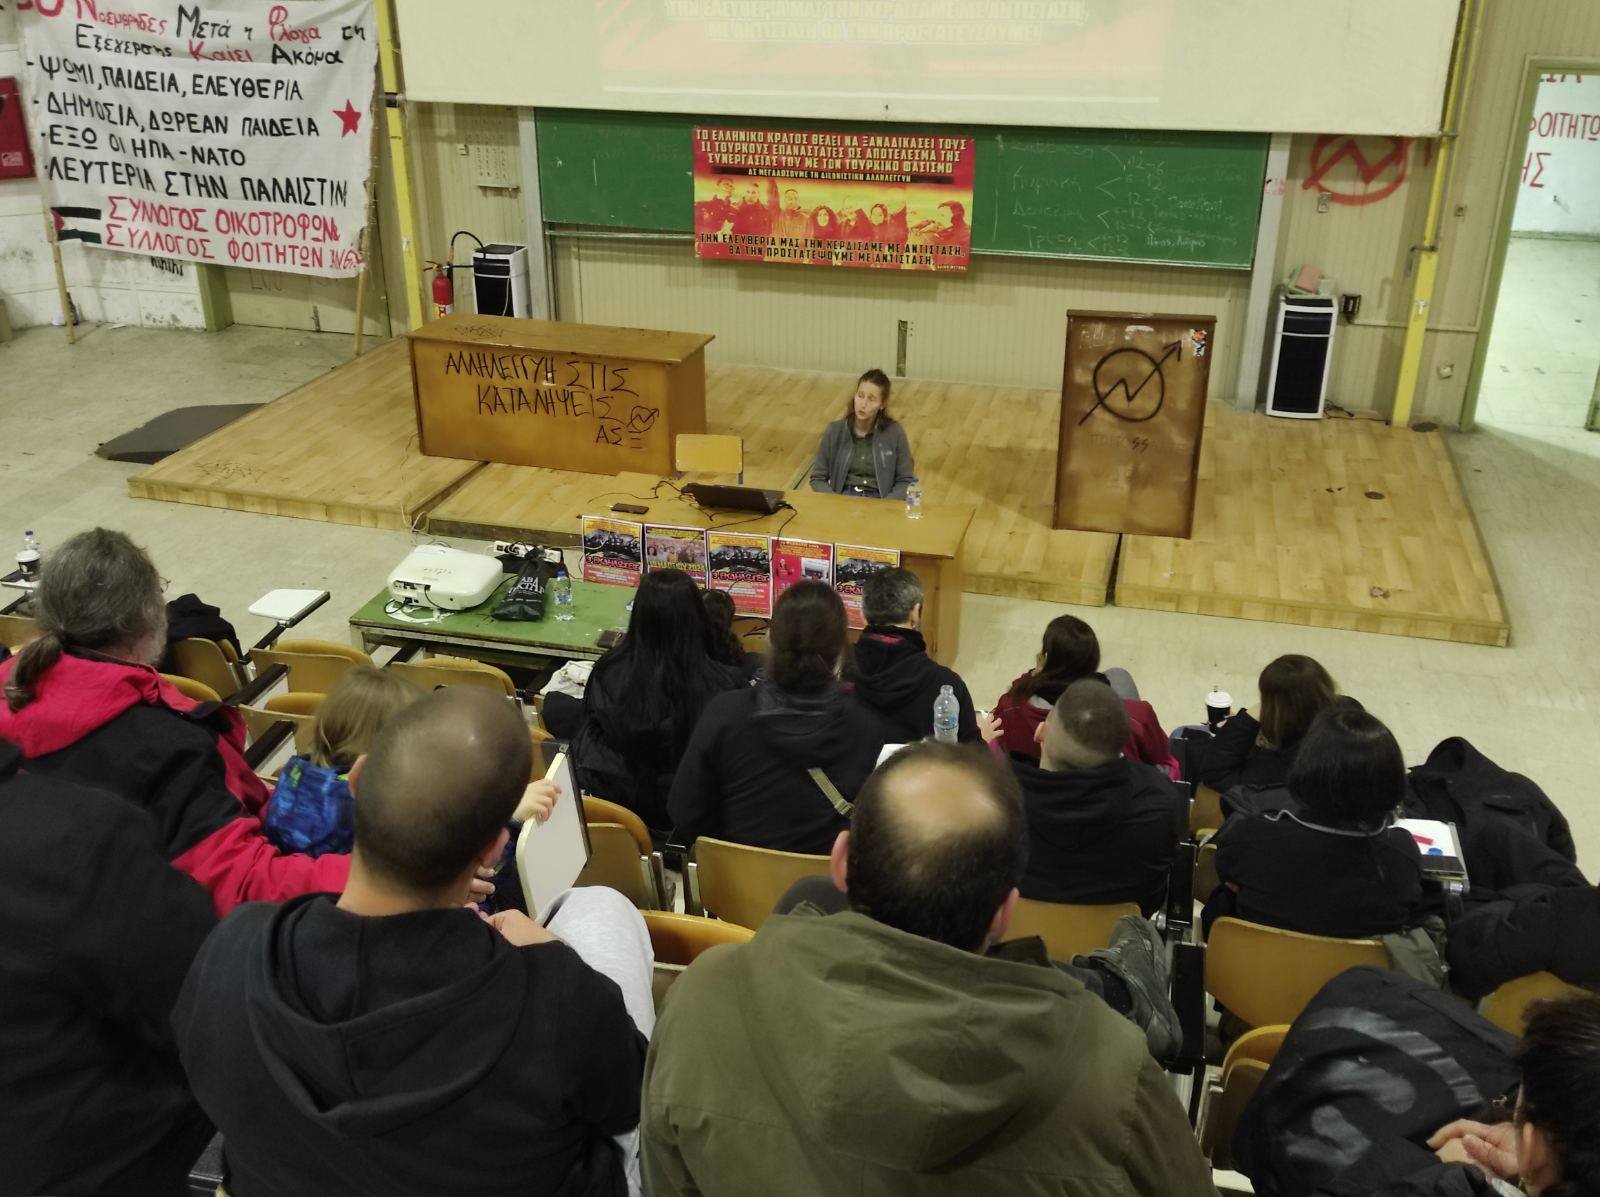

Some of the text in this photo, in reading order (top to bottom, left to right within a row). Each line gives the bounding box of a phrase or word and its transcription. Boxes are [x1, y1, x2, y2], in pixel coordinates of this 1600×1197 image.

[192, 74, 304, 101] ΕΛΕΥΘΕΡΙΑ
[149, 110, 228, 135] ΔΩΡΕΑΝ
[241, 117, 320, 137] ΠΑΙΔΕΙΑ
[696, 130, 967, 150] ΤΟ ΕΛΛΗΝΙΚΟ ΚΡΑΤΟΣ ΘΕΛΕΙ ΝΑ ΞΑΝΑΔΙΚΑΣΕΙ ΤΟΥΣ
[715, 142, 769, 155] ΤΟΥΡΚΟΥΣ
[772, 144, 845, 158] ΕΠΑΝΑΣΤΑΤΕΣ
[866, 148, 937, 162] ΑΠΟΤΕΛΕΣΜΑ
[940, 151, 961, 162] ΤΗΣ
[708, 153, 953, 174] ΣΥΝΕΡΓΑΣΙΑΣ ΤΟΥ ΜΕ ΤΟΝ ΤΟΥΡΚΙΚΟ ΦΑΣΙΣΜΟ
[165, 171, 228, 199] ΣΤΗΝ
[106, 223, 215, 258] ΣΥΛΛΟΓΟΣ
[228, 237, 323, 268] ΦΟΙΤΗΤΩΝ
[700, 233, 719, 243] ΤΗΝ
[722, 234, 776, 247] ΕΛΕΥΘΕΡΙΑ
[780, 238, 800, 248] ΜΑΣ
[804, 238, 822, 249] ΤΗΝ
[826, 240, 883, 252] ΚΕΡΔΙΣΑΜΕ
[888, 243, 900, 253] ΜΕ
[729, 245, 741, 255] ΘΑ
[745, 246, 763, 256] ΤΗΝ
[766, 247, 853, 261] ΠΡΟΣΤΑΤΕΨΟΥΜΕ
[858, 252, 871, 262] ΜΕ
[566, 361, 639, 397] ΣΤΙΣ
